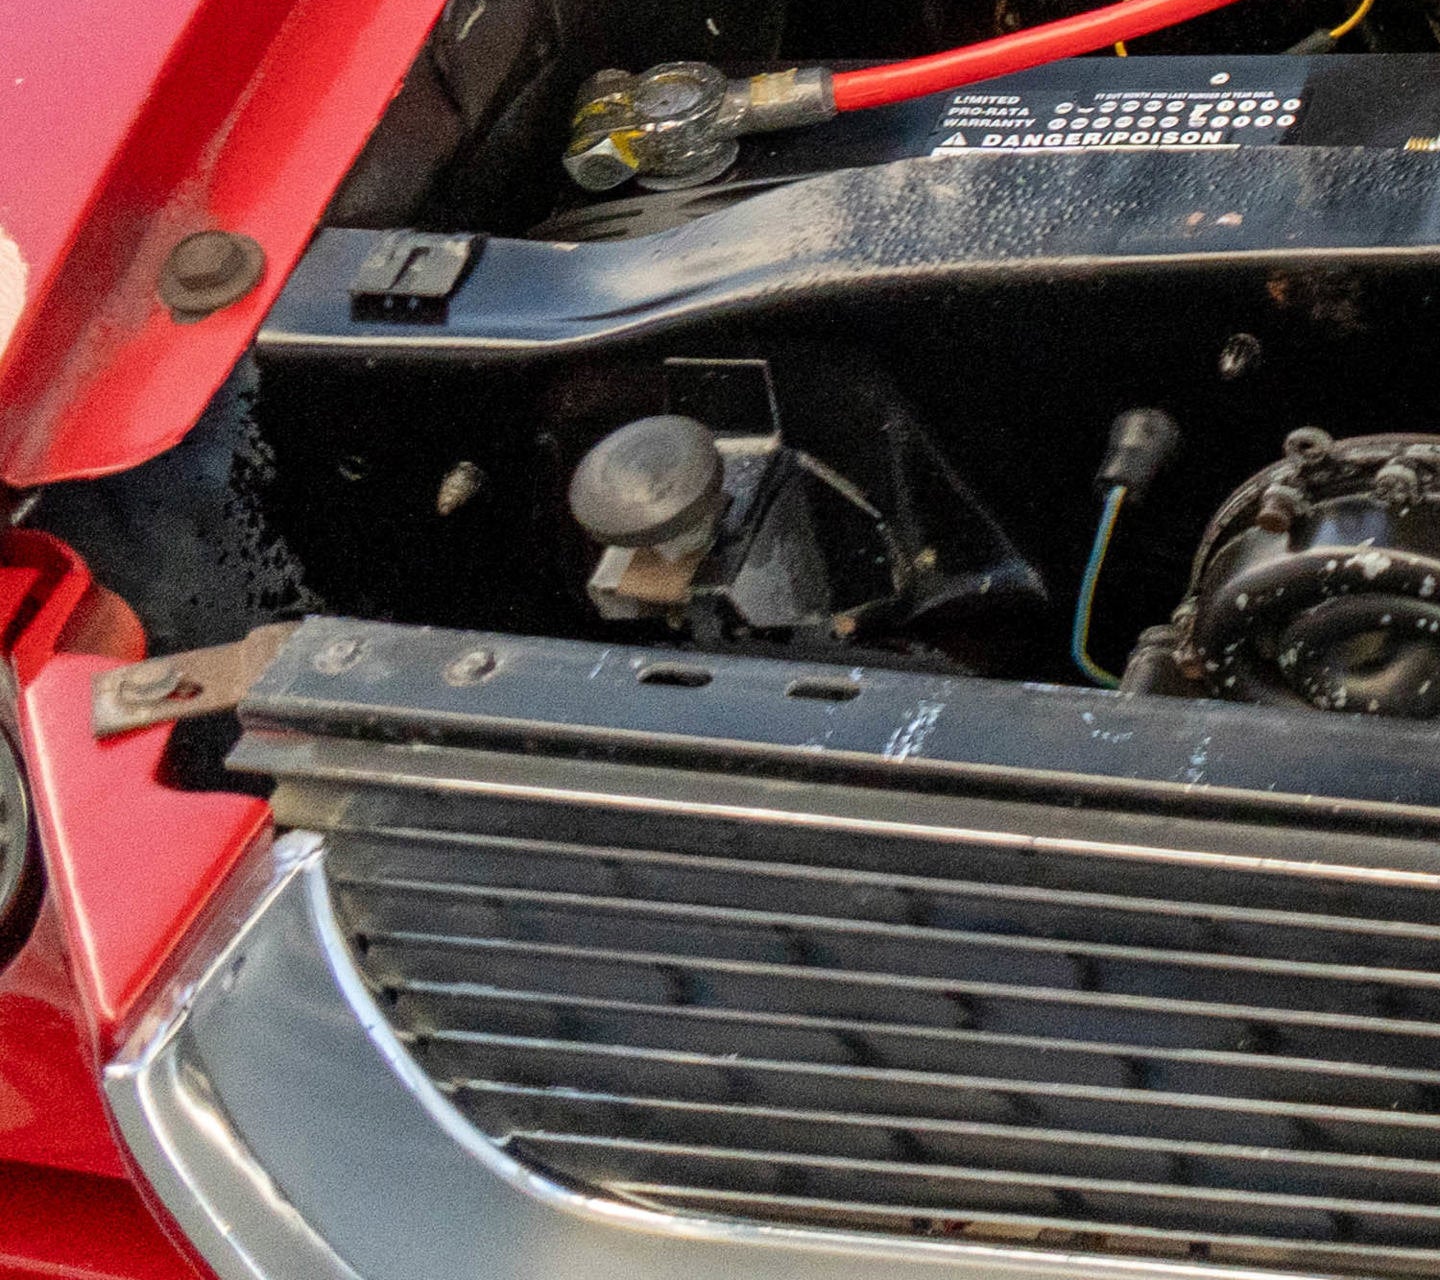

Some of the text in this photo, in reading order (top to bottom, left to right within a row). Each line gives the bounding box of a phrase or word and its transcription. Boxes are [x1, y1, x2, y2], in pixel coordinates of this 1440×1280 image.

[953, 95, 1021, 105] LIMITED
[1168, 92, 1188, 100] LAST
[947, 107, 1031, 117] PRO-RATA
[942, 118, 1037, 128] WARRANTY
[981, 130, 1224, 146] DANGER/POISON
